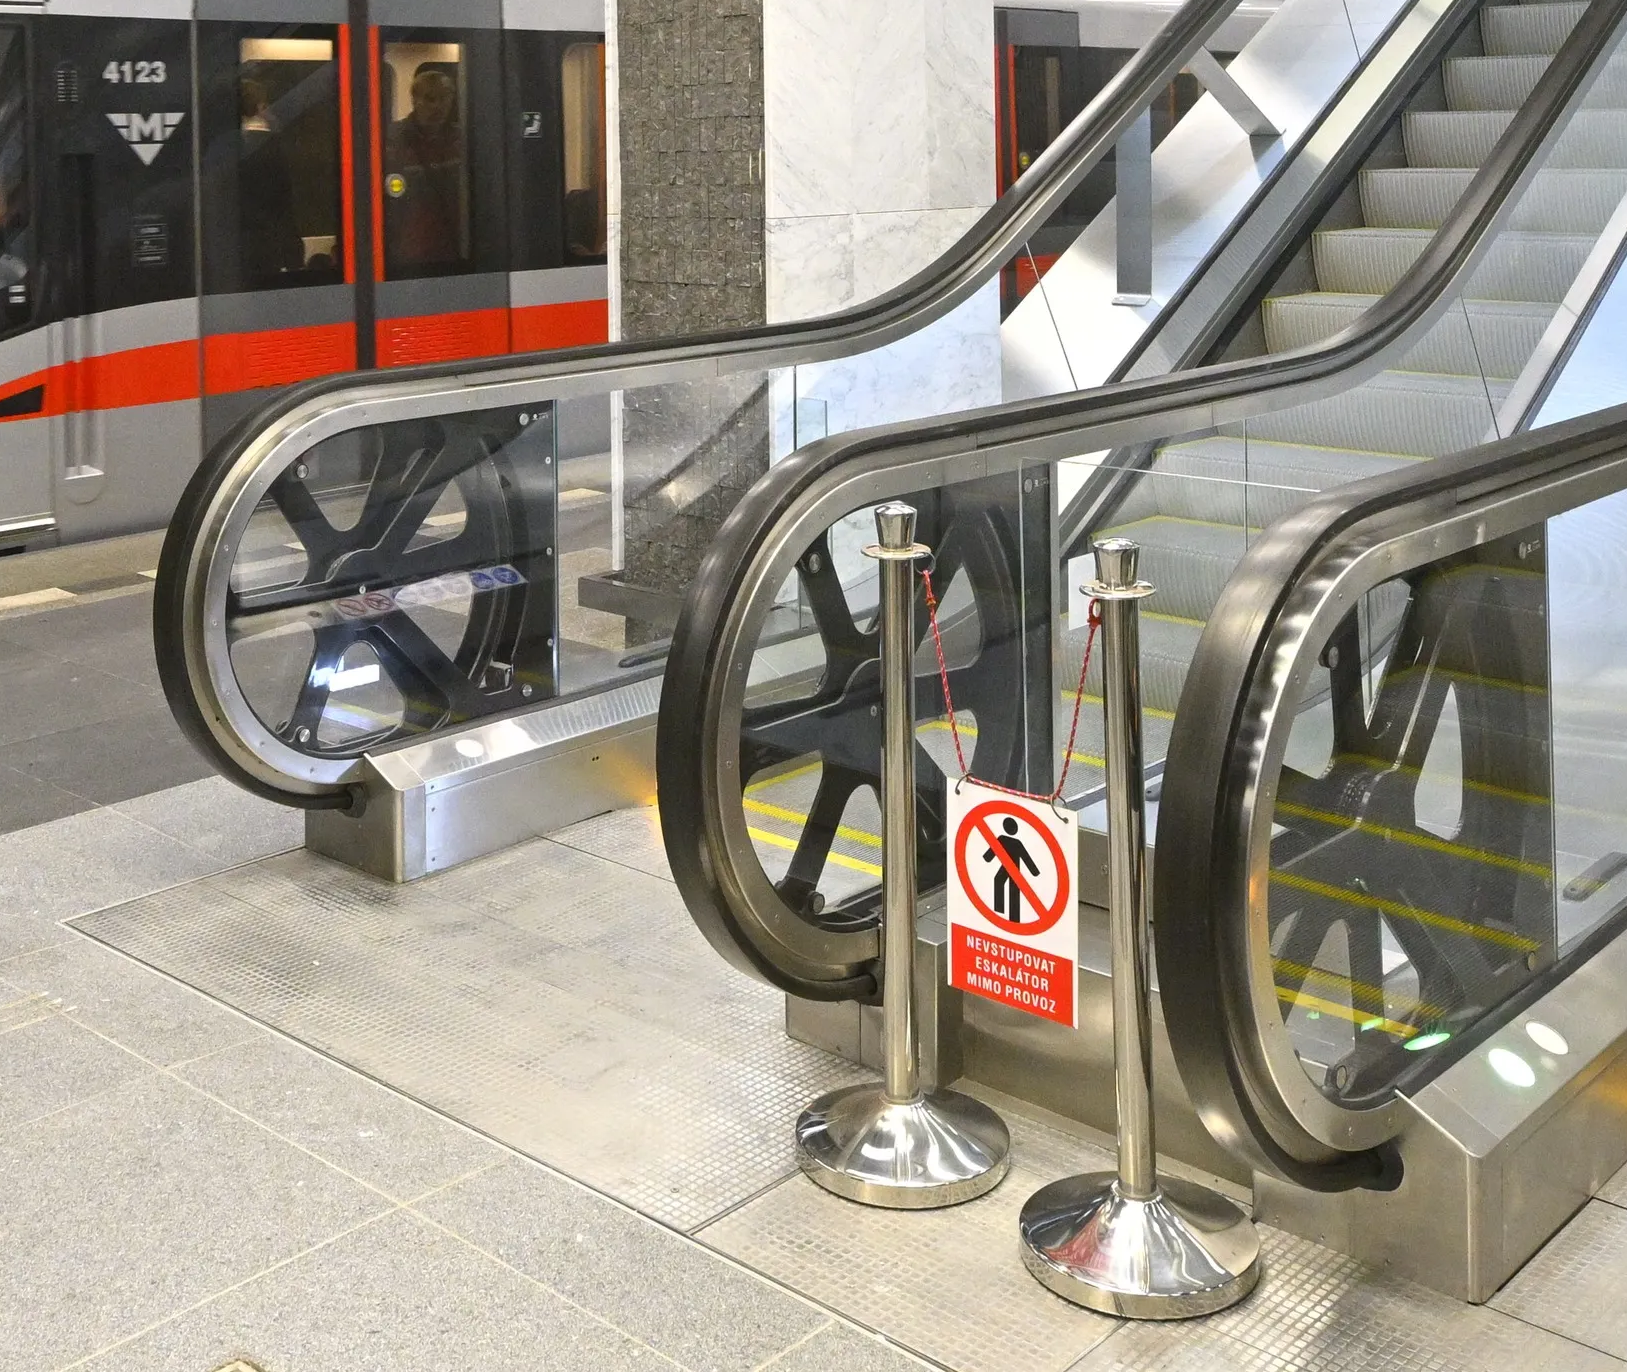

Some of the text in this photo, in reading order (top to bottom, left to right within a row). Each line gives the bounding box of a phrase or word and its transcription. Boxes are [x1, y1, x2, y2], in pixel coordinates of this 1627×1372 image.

[102, 60, 167, 84] 4123
[966, 934, 1056, 975] NEVSTUPOVAT
[975, 955, 1050, 993] ESKALÁTOR
[966, 971, 1057, 1014] MIMO PROVOZ
